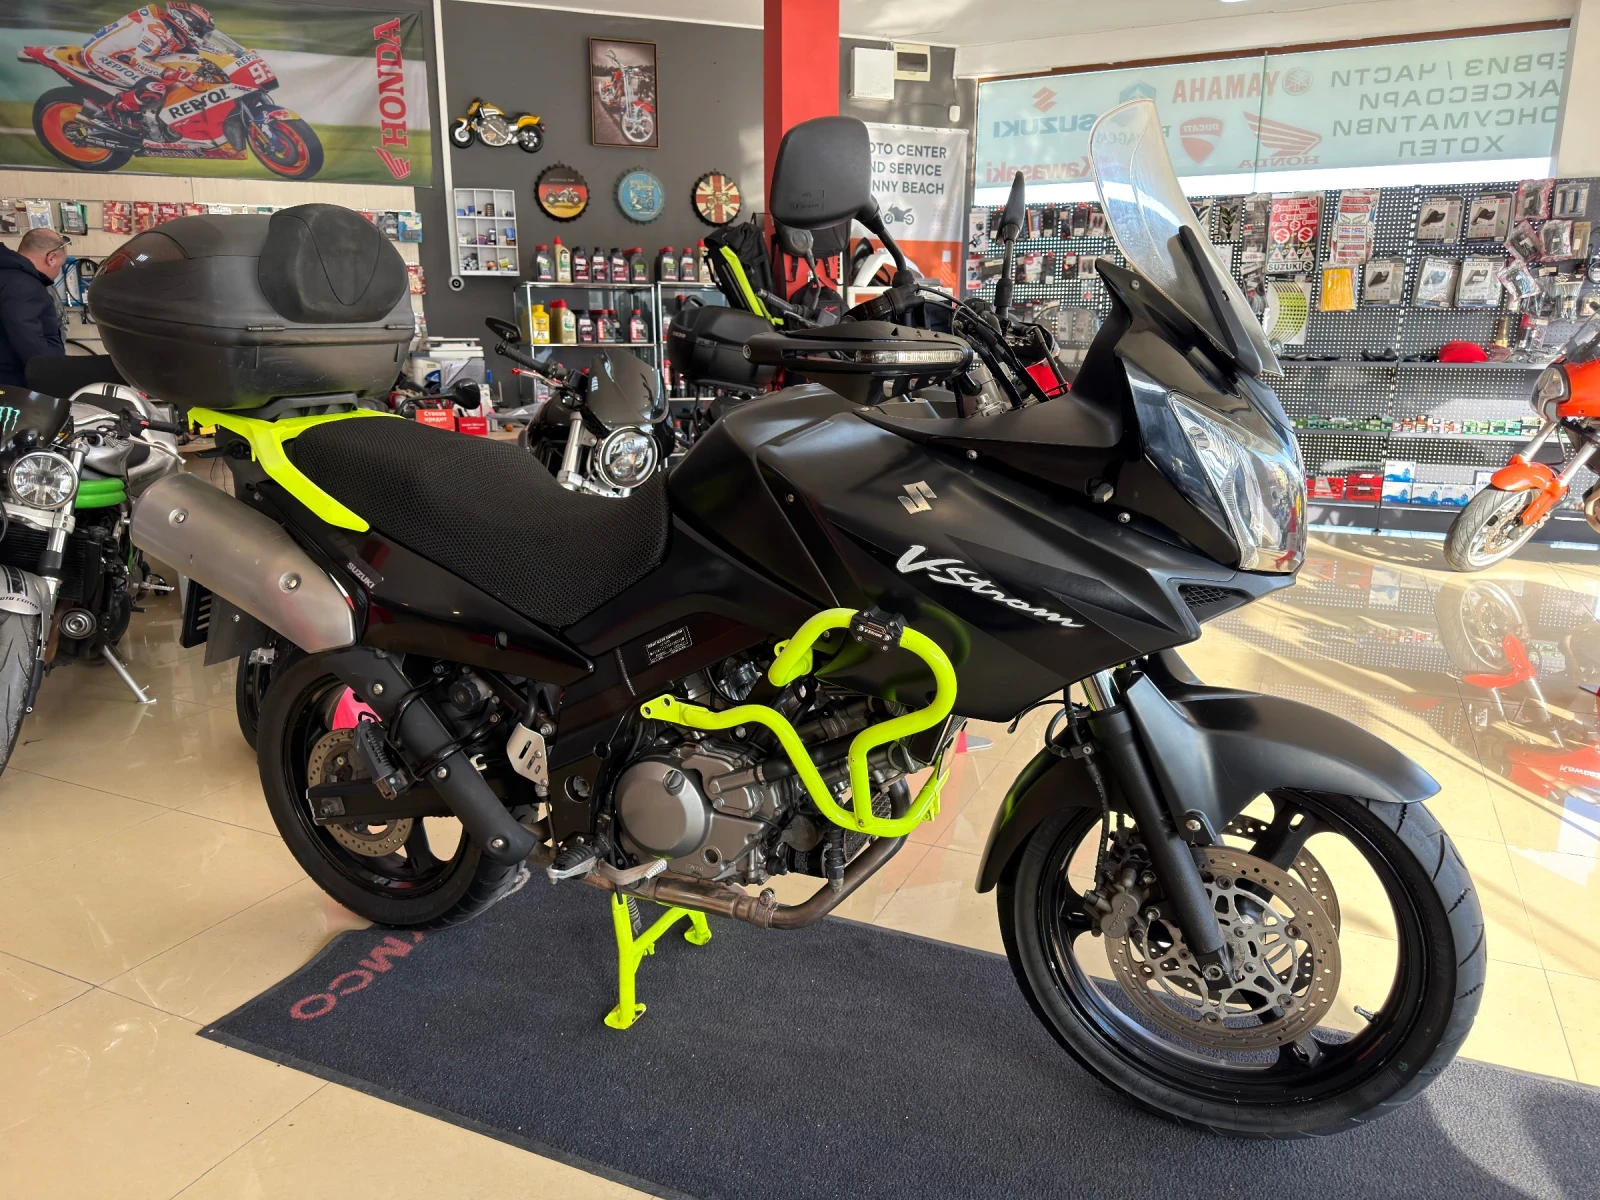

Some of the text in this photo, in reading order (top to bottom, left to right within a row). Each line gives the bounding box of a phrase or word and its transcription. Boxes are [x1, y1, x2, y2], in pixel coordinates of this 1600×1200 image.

[99, 56, 139, 81] REPSOL
[248, 61, 276, 85] 93
[373, 18, 408, 148] HONDA
[168, 87, 231, 120] REPSOL
[870, 143, 947, 159] OTO CENTER
[871, 161, 942, 176] ND SERVICE
[872, 179, 944, 195] NNY BEACH
[1268, 263, 1302, 271] SUZUKI
[347, 562, 376, 589] SUZUKI
